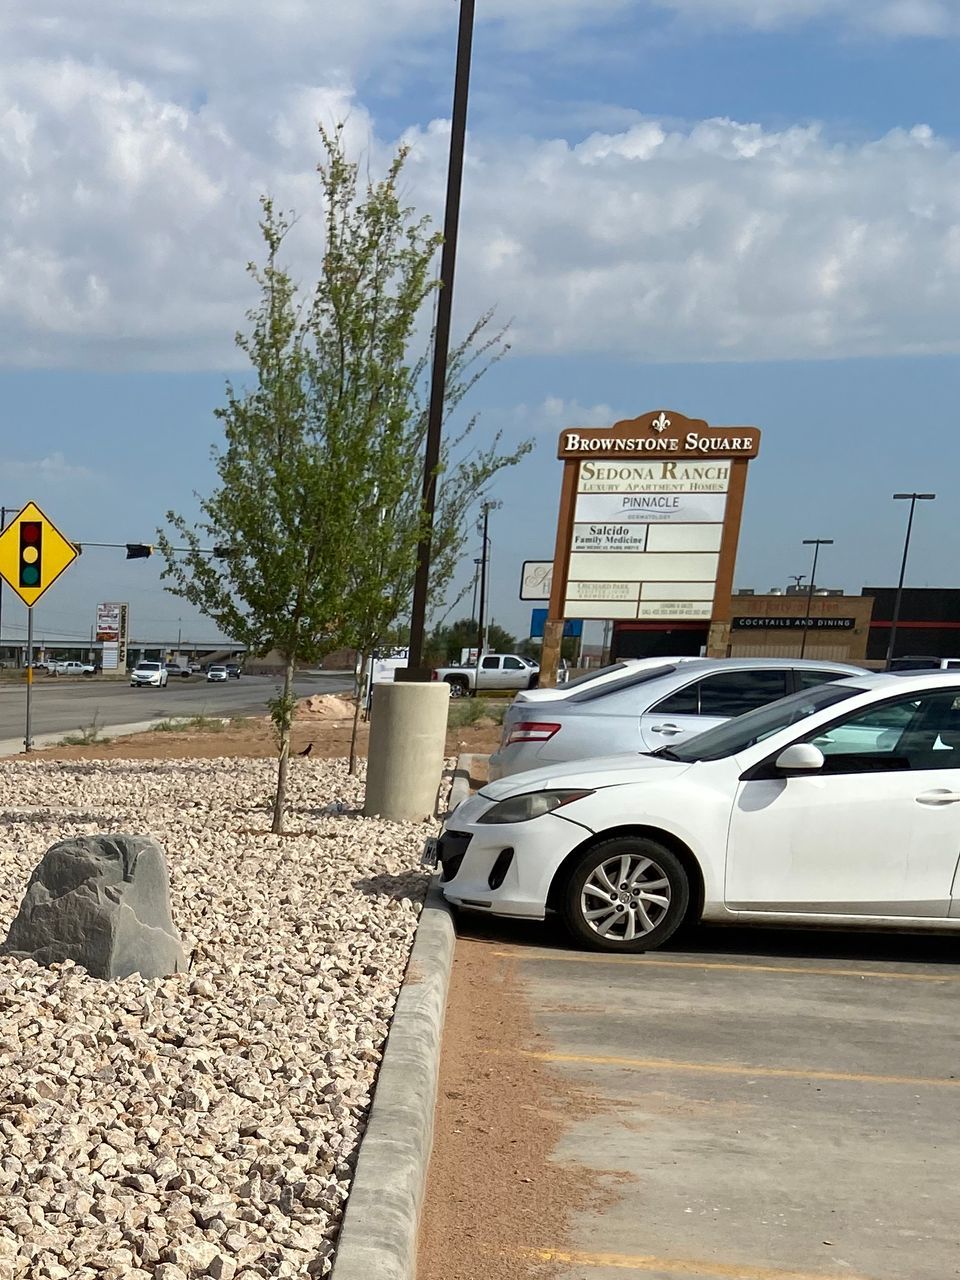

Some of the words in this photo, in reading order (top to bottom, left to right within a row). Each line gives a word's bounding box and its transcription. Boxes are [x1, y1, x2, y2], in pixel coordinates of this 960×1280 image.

[565, 434, 678, 451] BROWNSTONE
[685, 433, 752, 452] SQUARE
[581, 462, 654, 480] SEDONA
[660, 462, 728, 480] RANCH
[583, 483, 619, 491] LUXURY
[625, 483, 684, 491] APARTMENT
[689, 483, 724, 491] HOMES
[622, 497, 679, 508] PINNACLE
[589, 525, 629, 536] Salcido
[575, 536, 602, 545] Family
[605, 536, 642, 544] Medicine
[794, 619, 814, 627] AND
[818, 619, 850, 627] DINING
